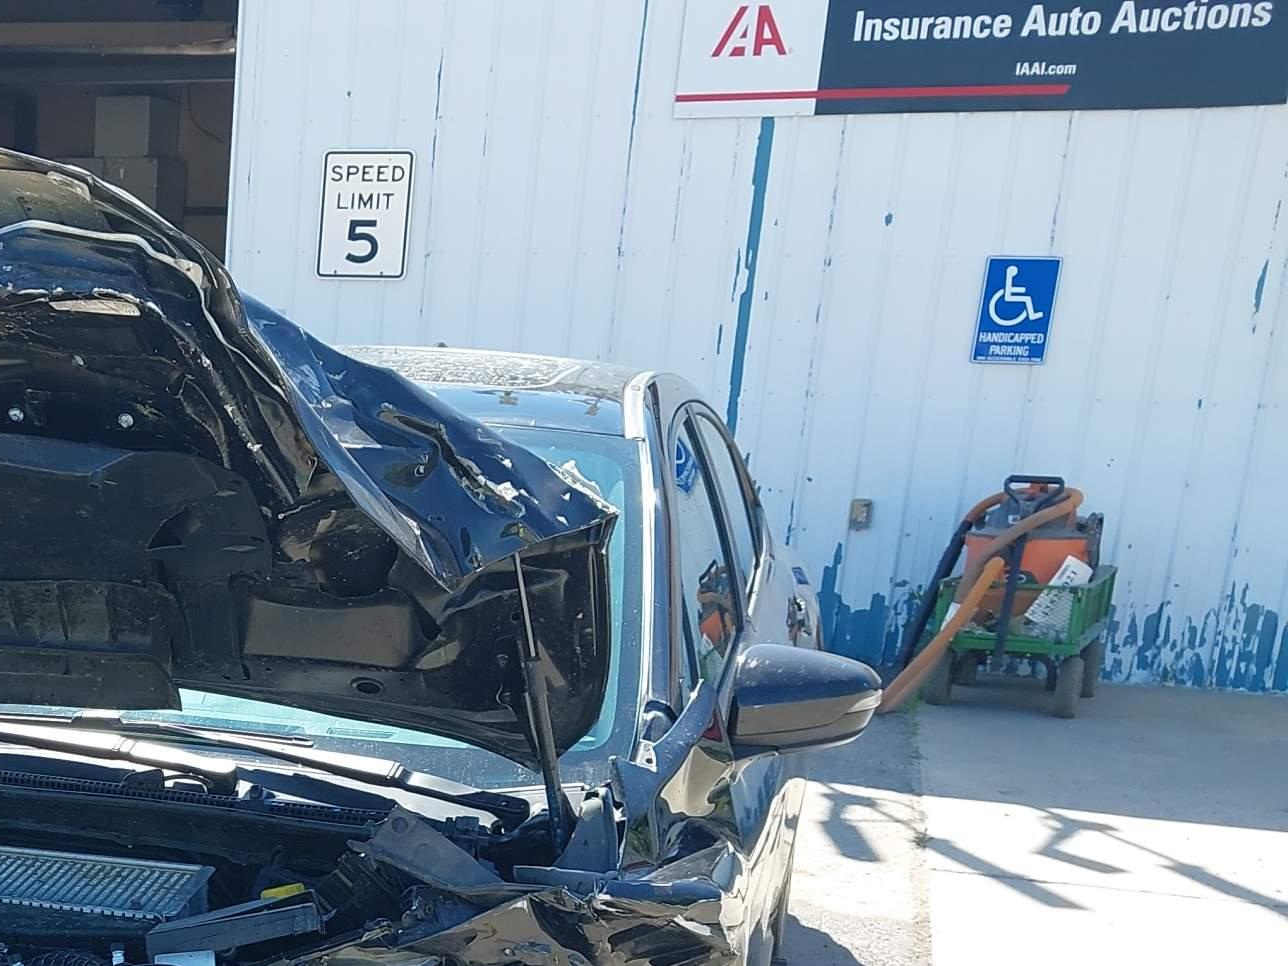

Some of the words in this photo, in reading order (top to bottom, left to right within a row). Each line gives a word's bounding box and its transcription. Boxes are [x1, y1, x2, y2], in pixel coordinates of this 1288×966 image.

[853, 10, 1012, 42] Insurance
[1020, 4, 1102, 37] Auto
[1110, 0, 1273, 34] Auctions
[1015, 61, 1077, 76] IAAI.com
[330, 165, 405, 182] SPEED
[336, 192, 395, 210] LIMIT
[344, 219, 379, 264] 5
[978, 331, 1044, 344] HANDICAPPED
[988, 344, 1030, 357] PARKING
